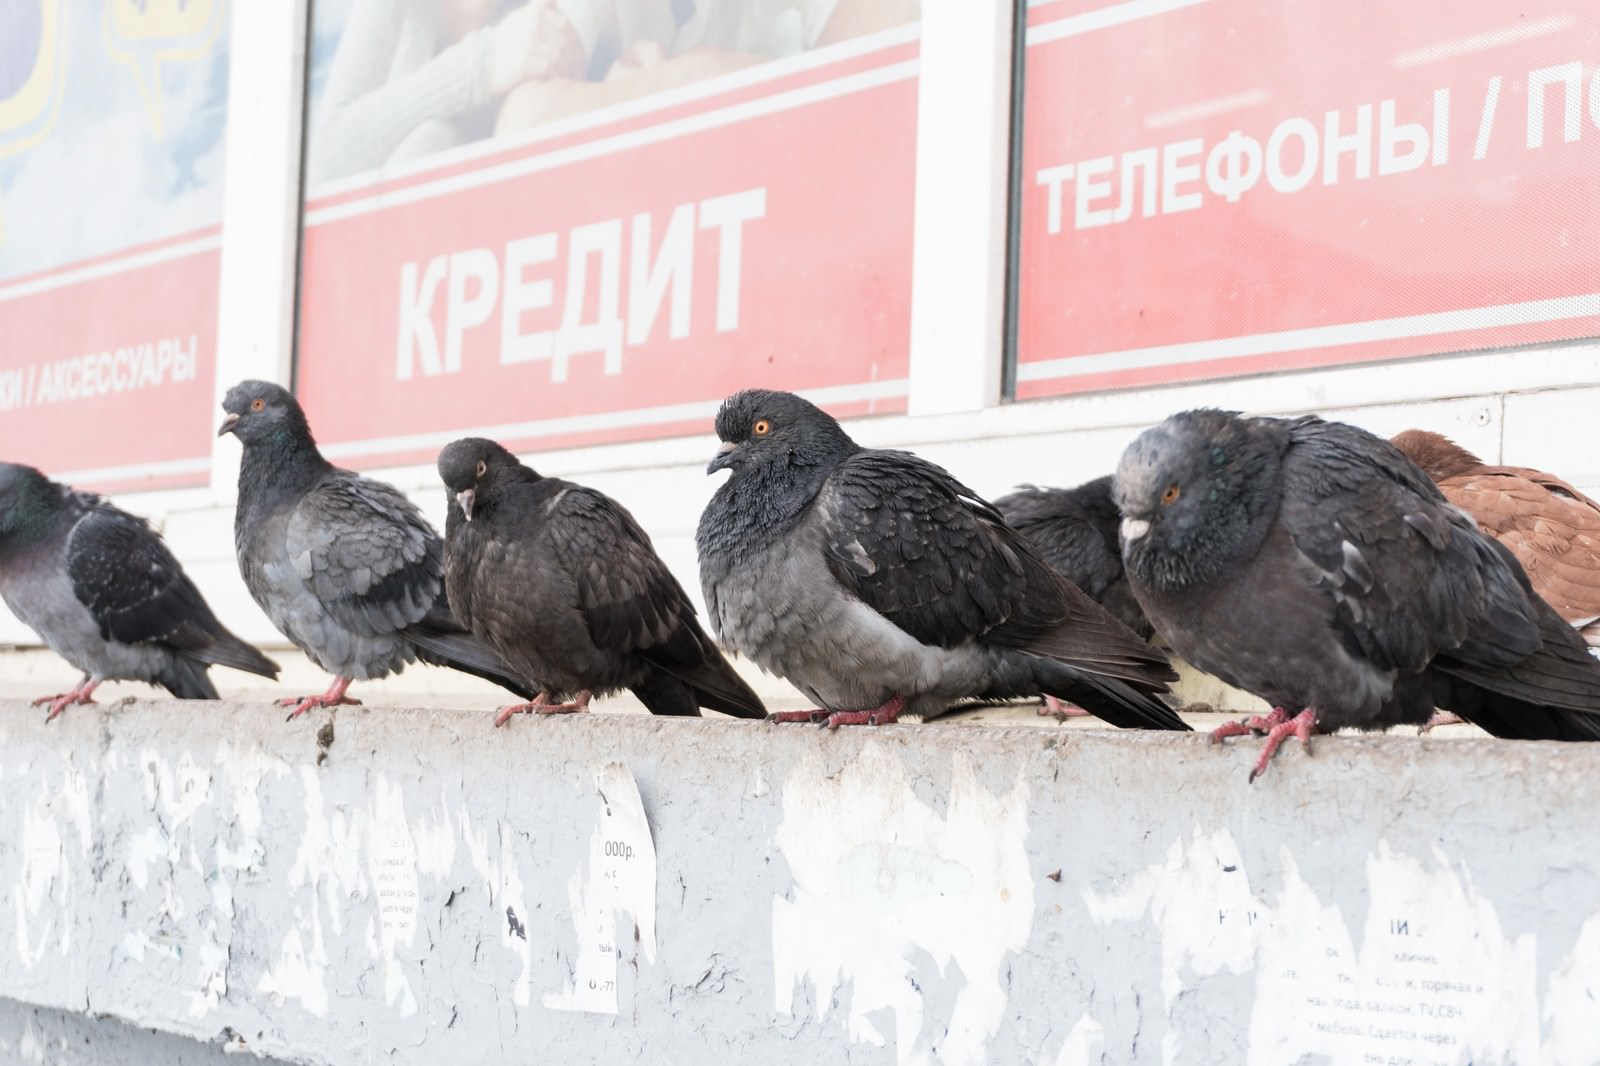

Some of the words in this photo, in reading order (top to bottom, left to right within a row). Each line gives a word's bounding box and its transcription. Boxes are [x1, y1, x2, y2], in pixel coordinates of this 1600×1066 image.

[1036, 87, 1449, 235] ТЕЛЕФОНЫ
[1525, 61, 1600, 150] П
[35, 335, 198, 408] АКСЕССУАРЫ
[395, 187, 767, 383] КРЕДИТ
